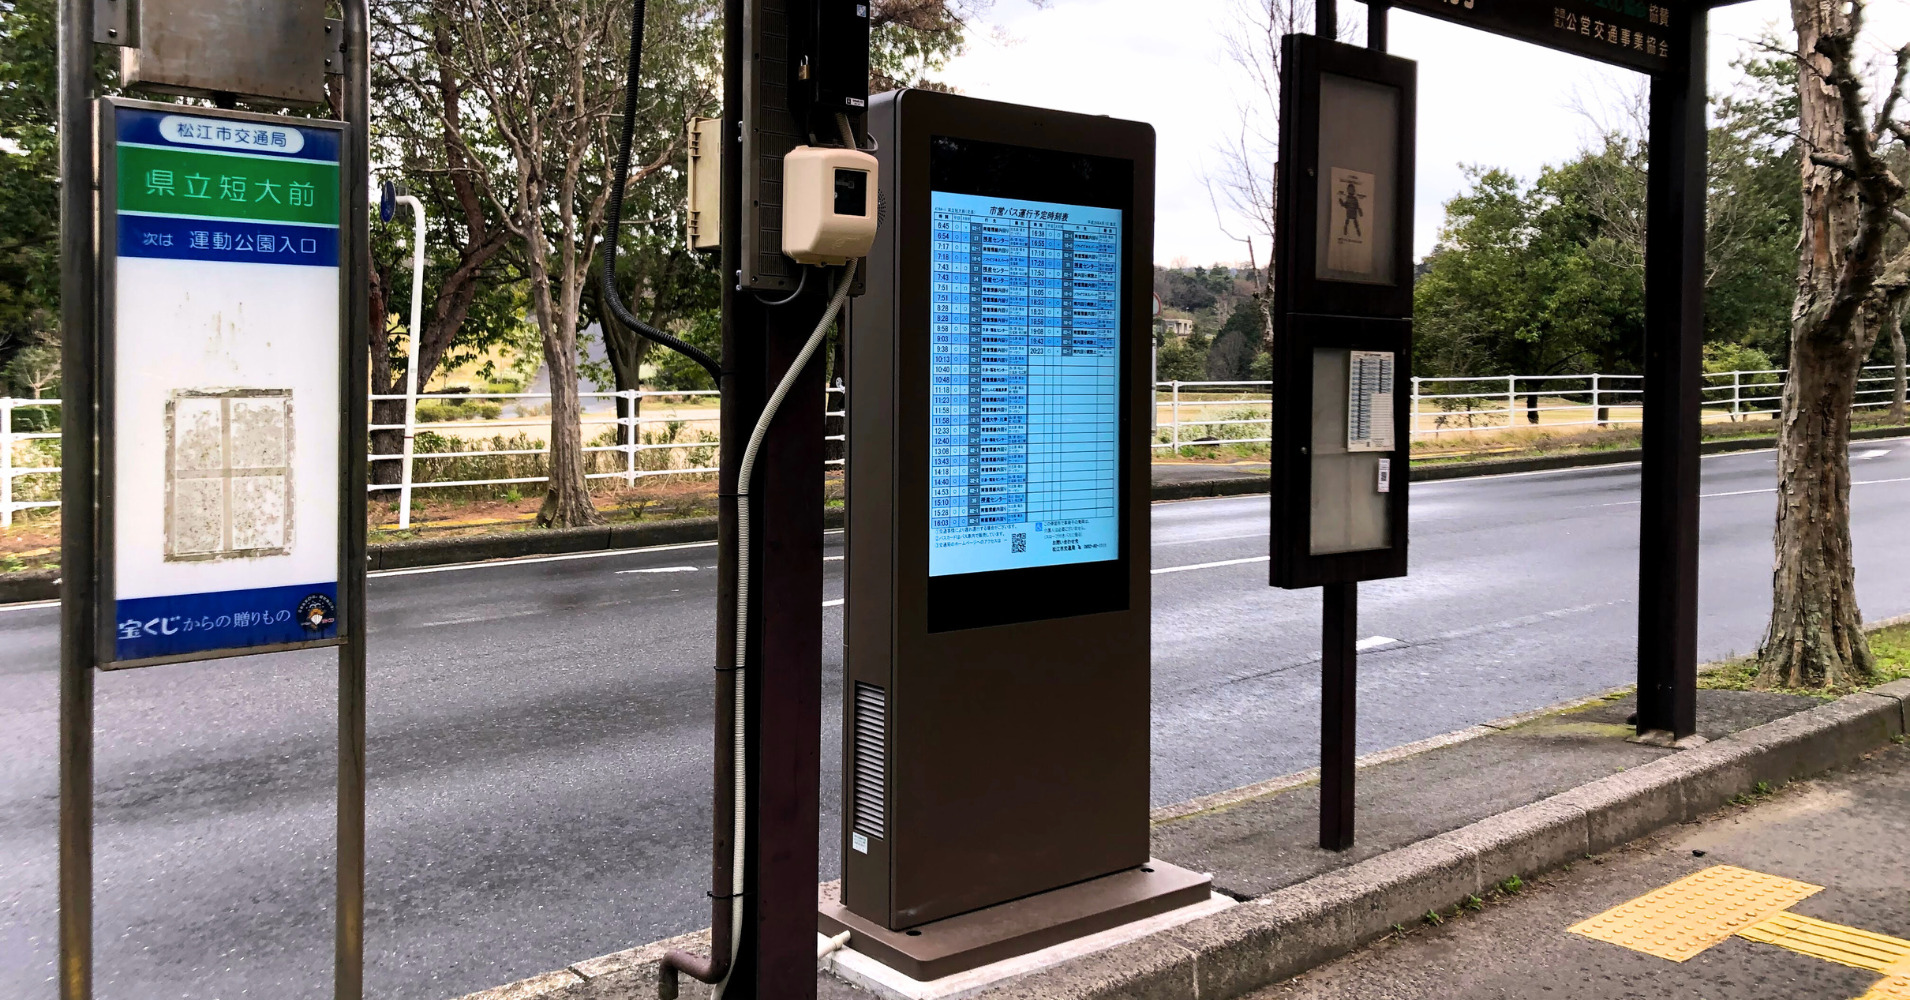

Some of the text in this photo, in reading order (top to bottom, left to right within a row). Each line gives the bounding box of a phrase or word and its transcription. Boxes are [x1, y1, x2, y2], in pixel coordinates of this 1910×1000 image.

[1566, 12, 1668, 58] 公営交通事業協会
[177, 122, 287, 147] 松江市交通局
[145, 168, 316, 207] 県立短大前
[989, 205, 1069, 222] 市営バス運行予定時刻表
[143, 230, 317, 254] 次は 運動公園入口
[118, 609, 291, 640] 宝くじからの贈りもの
